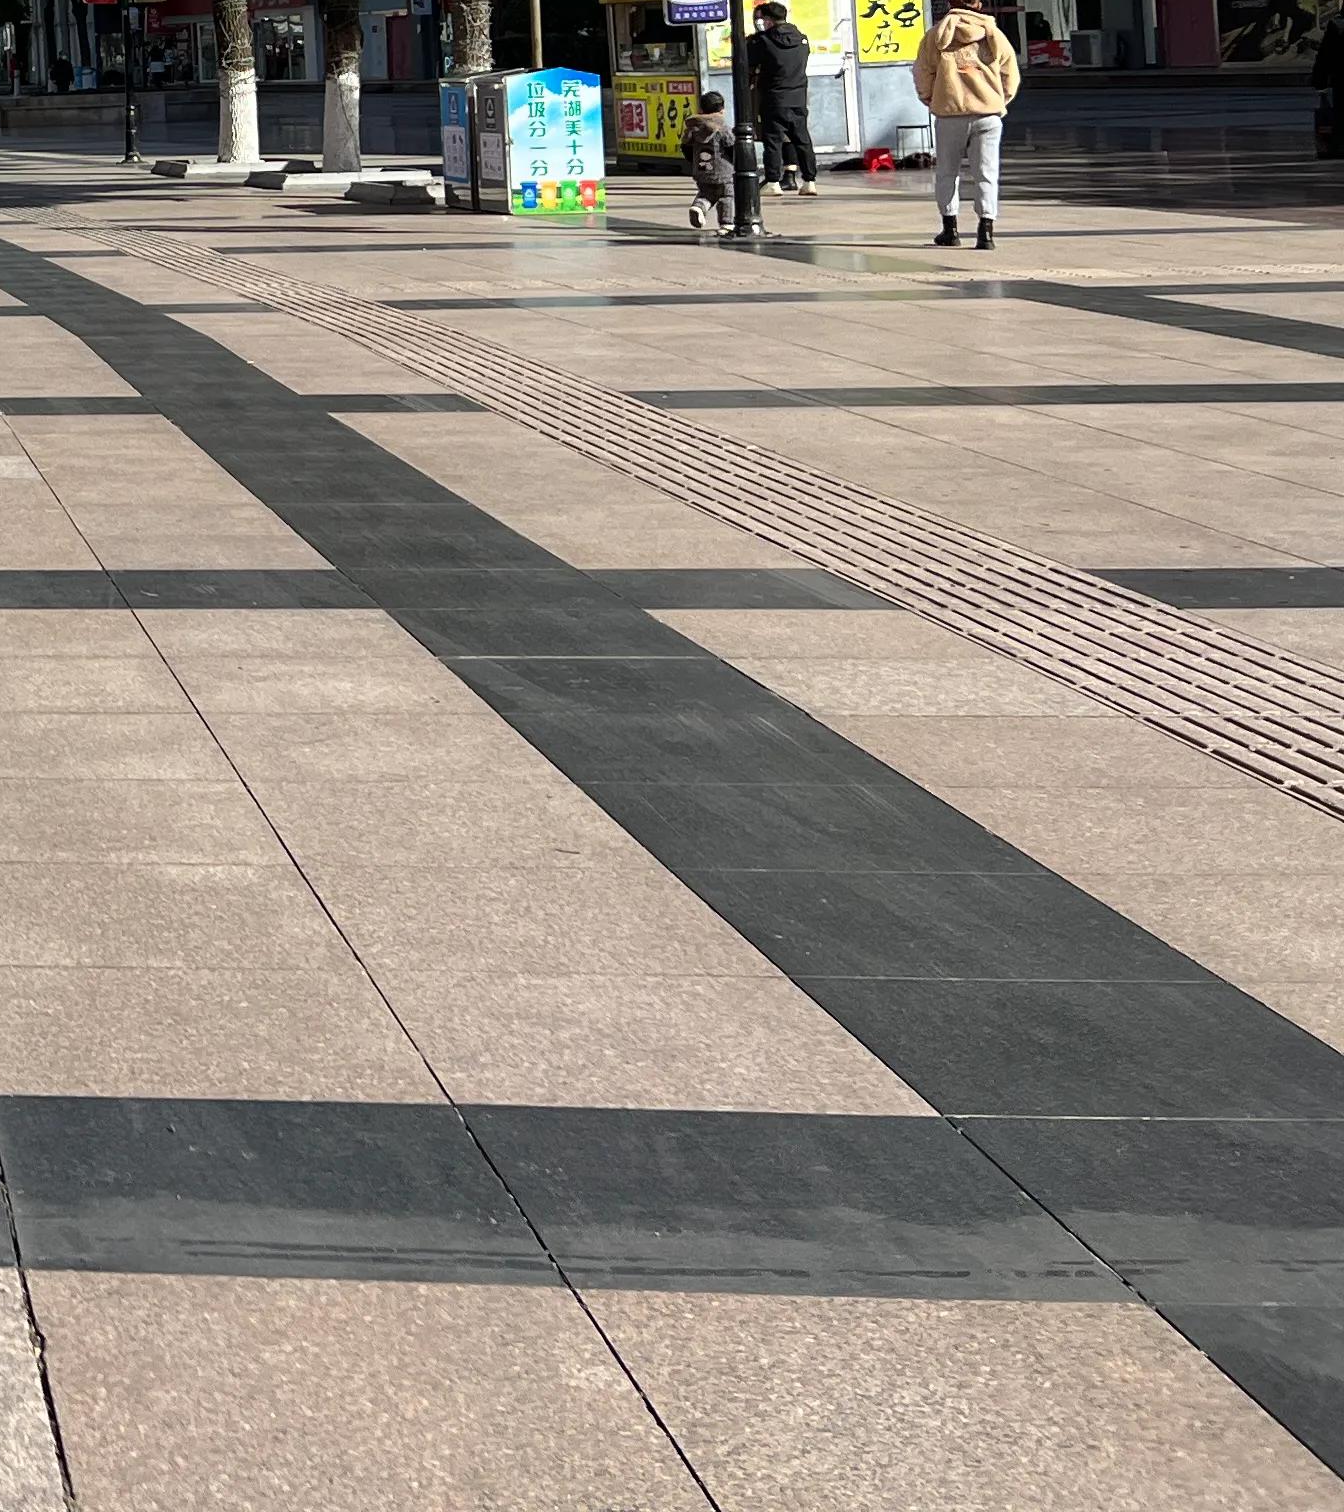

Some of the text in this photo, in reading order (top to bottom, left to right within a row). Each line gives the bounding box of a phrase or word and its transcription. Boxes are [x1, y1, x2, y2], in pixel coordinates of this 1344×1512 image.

[527, 81, 548, 177] 垃圾分一分
[562, 80, 585, 176] 芜湖美十分
